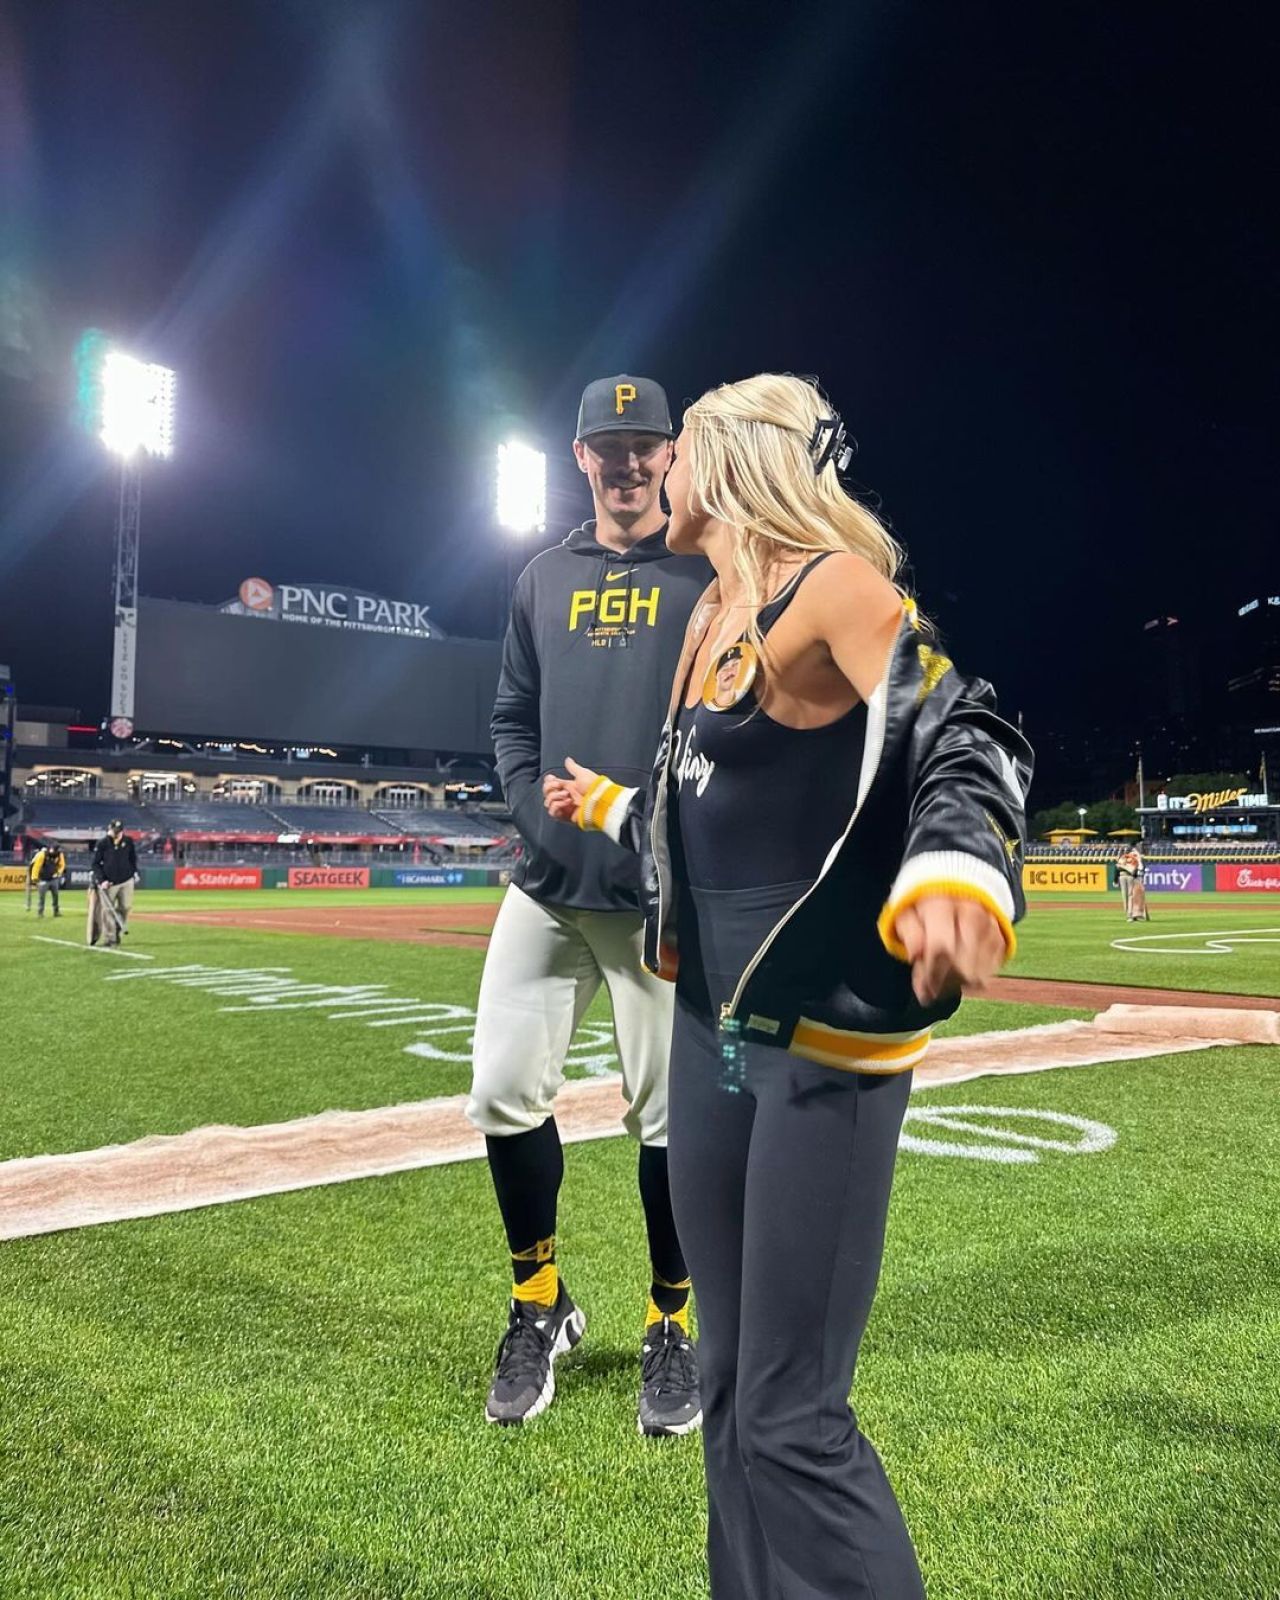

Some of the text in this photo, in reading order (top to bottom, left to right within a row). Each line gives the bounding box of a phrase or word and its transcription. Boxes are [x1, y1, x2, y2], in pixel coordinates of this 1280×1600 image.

[615, 384, 636, 414] P
[278, 585, 431, 629] PNC PARK
[281, 613, 308, 623] HOME
[310, 617, 322, 625] OF
[325, 618, 342, 628] THE
[569, 587, 660, 631] PGH
[1187, 788, 1248, 815] Miller
[1239, 794, 1268, 807] TIME
[294, 871, 364, 886] SEATGEEK
[1051, 871, 1099, 885] LIGHT
